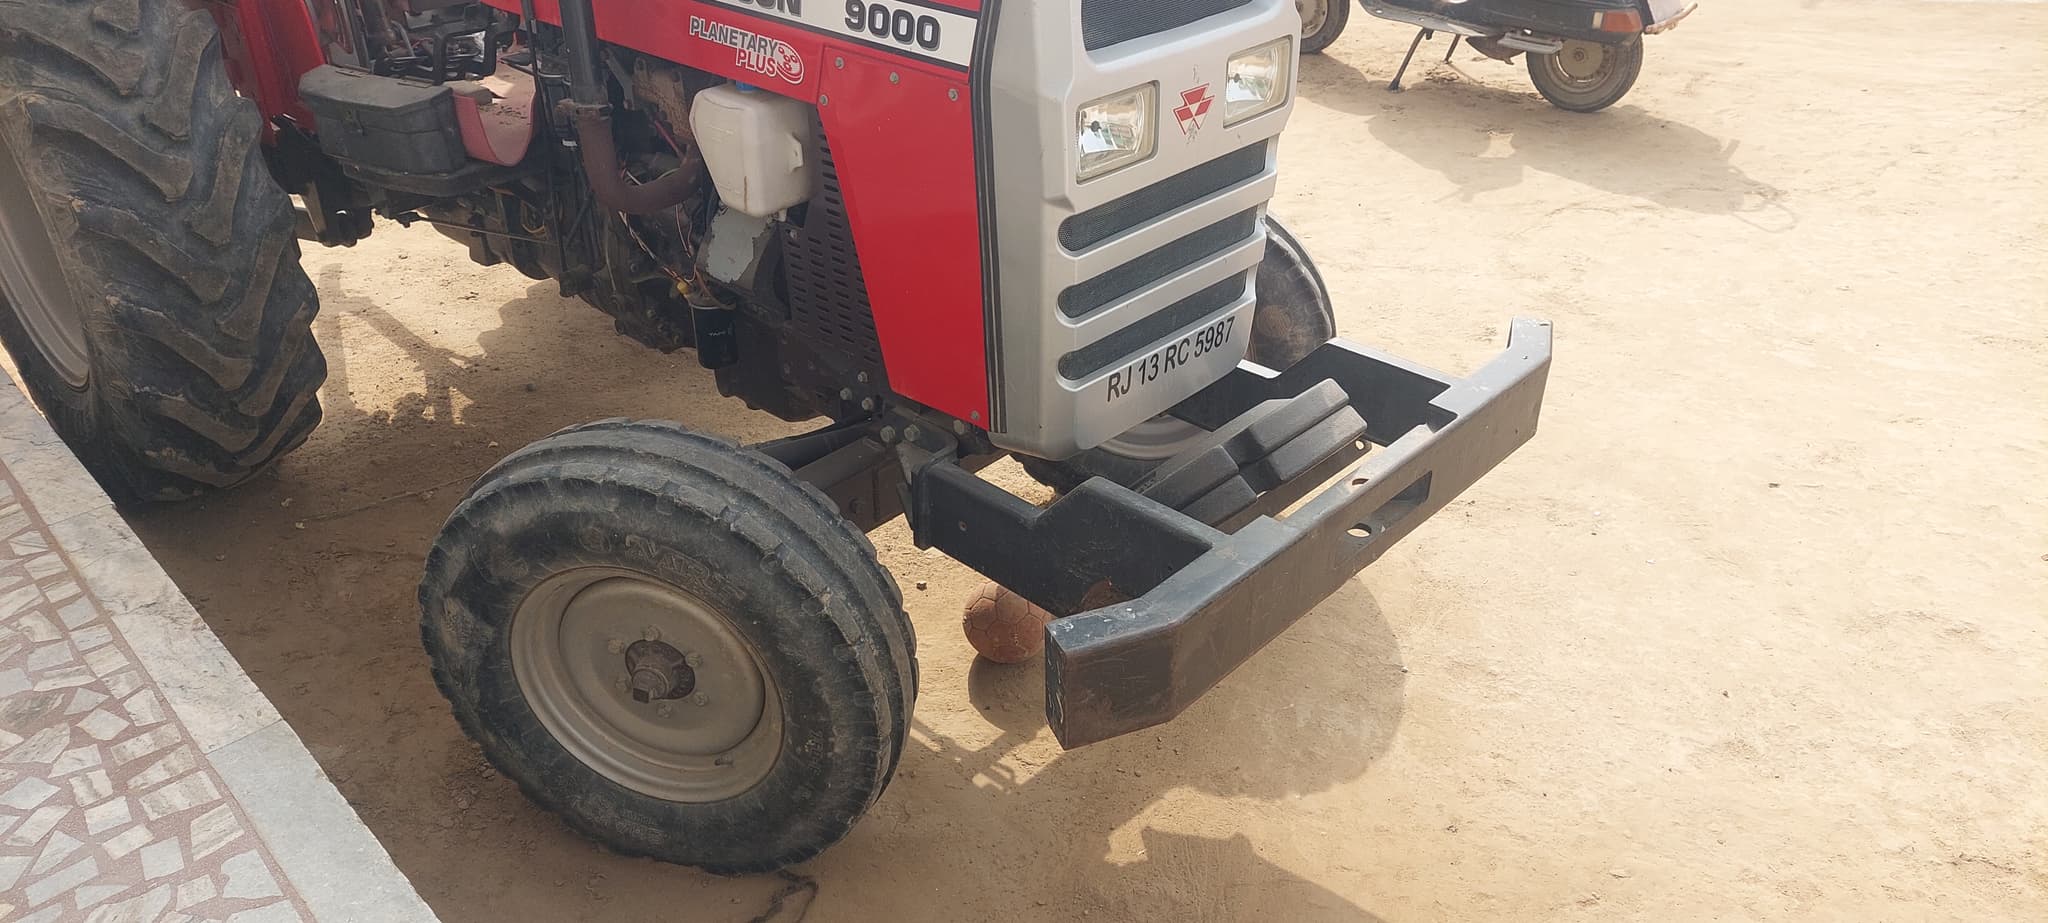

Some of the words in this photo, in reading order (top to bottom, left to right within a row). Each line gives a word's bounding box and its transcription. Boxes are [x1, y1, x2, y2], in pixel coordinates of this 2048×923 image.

[690, 17, 778, 57] PLANETARY
[845, 0, 941, 50] 9000
[737, 49, 776, 76] PLUS
[1107, 365, 1132, 402] RJ
[1138, 353, 1159, 386] 13
[1164, 338, 1190, 373] RC
[1194, 316, 1235, 358] 5987
